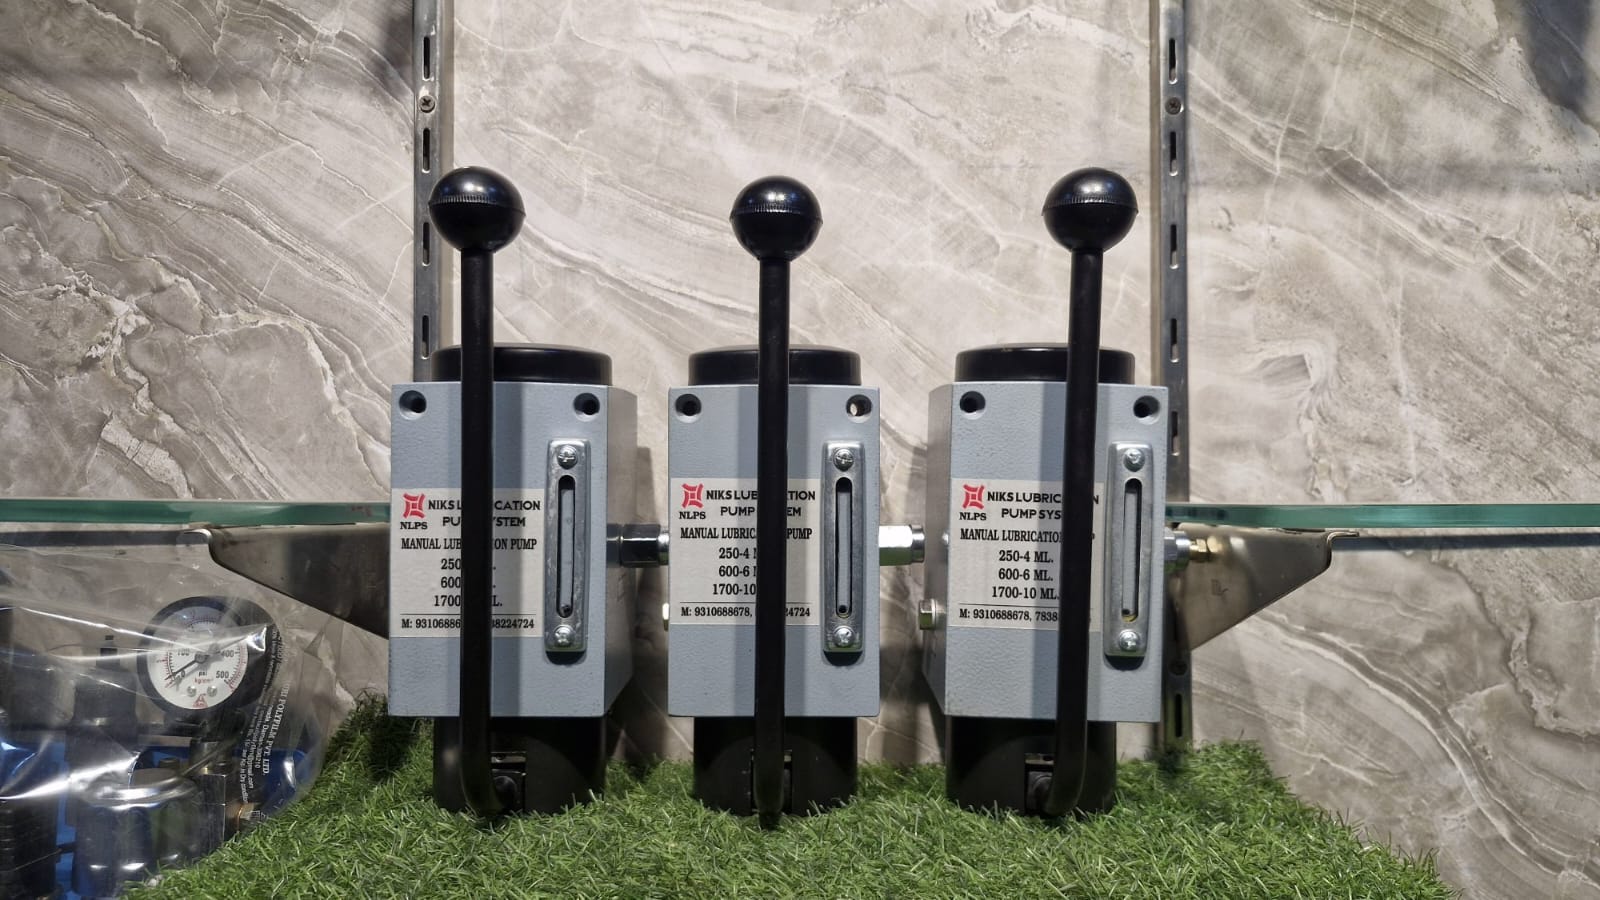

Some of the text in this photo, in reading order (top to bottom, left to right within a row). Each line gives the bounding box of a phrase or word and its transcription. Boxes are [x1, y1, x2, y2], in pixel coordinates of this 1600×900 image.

[706, 490, 816, 501] NIKS LUBTION
[987, 491, 1099, 505] NIKS LUBRICN
[428, 499, 541, 511] NIKS LCATION
[679, 511, 706, 520] NLPS
[720, 506, 755, 517] PUMP
[959, 512, 987, 521] NLPS
[1001, 508, 1062, 520] PUMP SYS
[400, 521, 428, 530] NLPS
[442, 516, 461, 527] PU
[680, 527, 719, 539] MANUAL
[787, 528, 813, 540] PUMP
[960, 528, 1062, 543] MANUAL LUBRICATIO
[401, 537, 441, 550] MANUAL
[510, 537, 537, 550] PUMP
[718, 547, 750, 560] 250-4
[998, 550, 1054, 563] 250-4 ML.
[718, 565, 750, 577] 600-6
[998, 568, 1054, 582] 600-6 ML.
[712, 583, 757, 596] 1700-10
[992, 586, 1061, 600] 1700-10 ML.
[681, 607, 692, 617] M:
[694, 606, 753, 618] 9310688678,
[959, 608, 971, 619] M:
[973, 609, 1032, 622] 9310688678,
[401, 618, 413, 629] M:
[220, 649, 235, 658] 400
[215, 670, 230, 679] 500
[268, 698, 287, 739] POLYFILM
